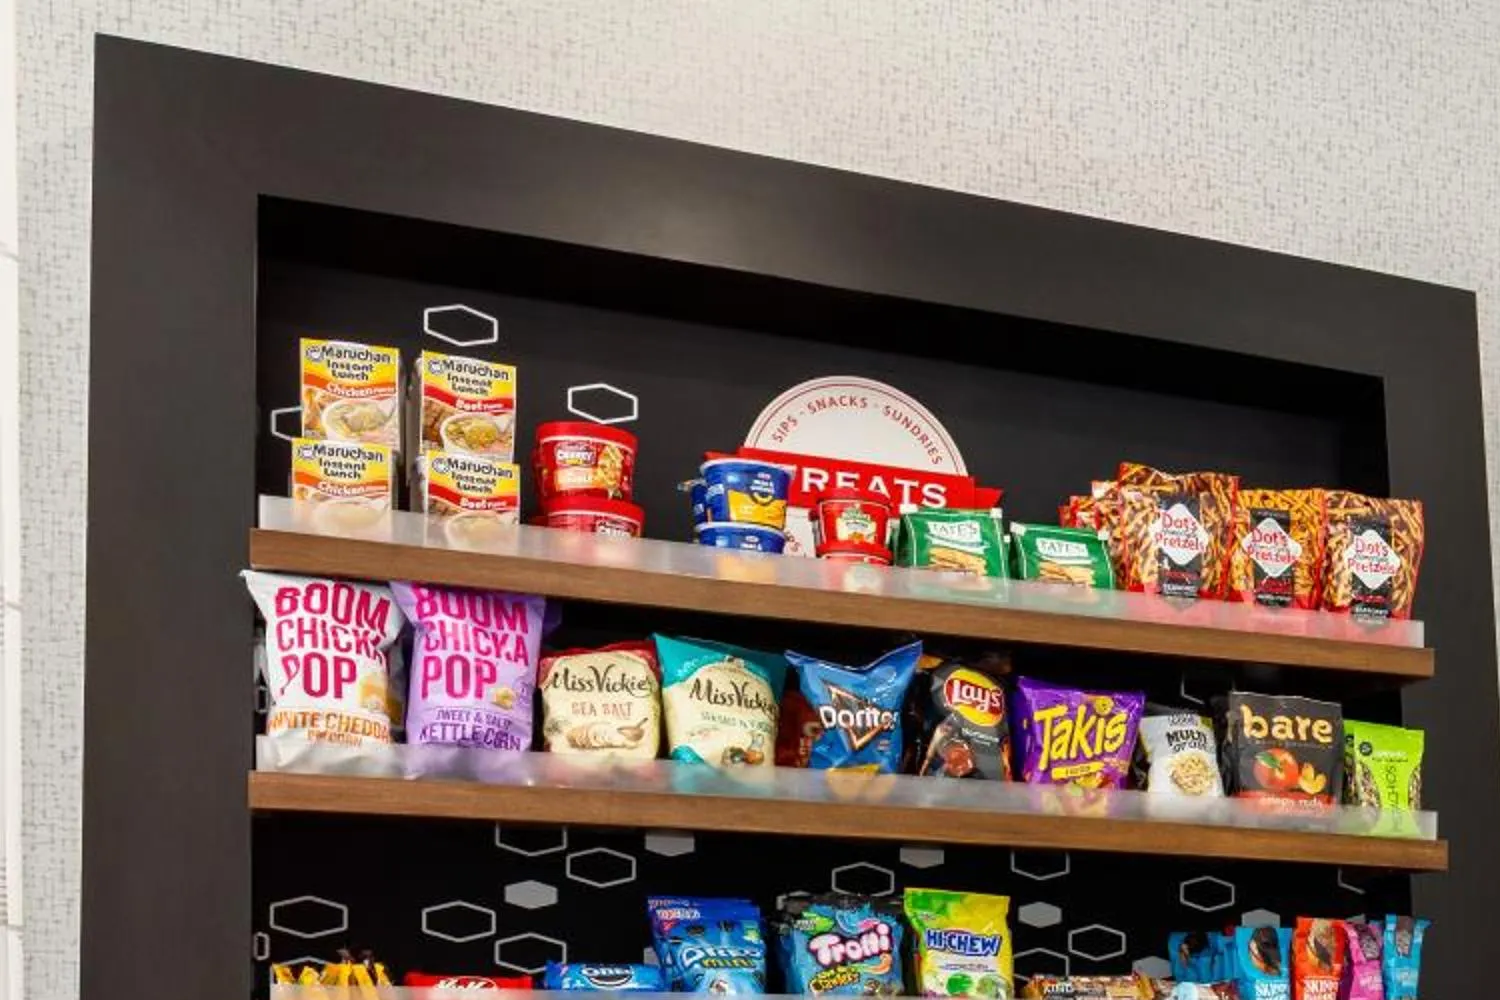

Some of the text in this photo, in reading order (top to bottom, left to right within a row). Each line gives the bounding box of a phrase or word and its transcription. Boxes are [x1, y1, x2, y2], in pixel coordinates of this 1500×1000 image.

[321, 346, 391, 364] Maruchan
[441, 360, 509, 380] Maruchan
[772, 395, 943, 465] SIPS SNACKS SUNDRIES
[314, 444, 384, 462] Maruchan
[448, 458, 513, 479] Maruchan
[802, 467, 947, 511] REATS
[1162, 513, 1198, 534] Dot's
[1252, 528, 1288, 546] Dot's
[1155, 532, 1206, 551] Pretzels
[275, 582, 391, 637] BOOM
[280, 652, 357, 699] POP
[422, 655, 497, 699] POP
[419, 721, 481, 742] KETTLE
[1033, 696, 1128, 771] Takis
[1240, 704, 1333, 744] bare
[809, 923, 891, 966] Trolli
